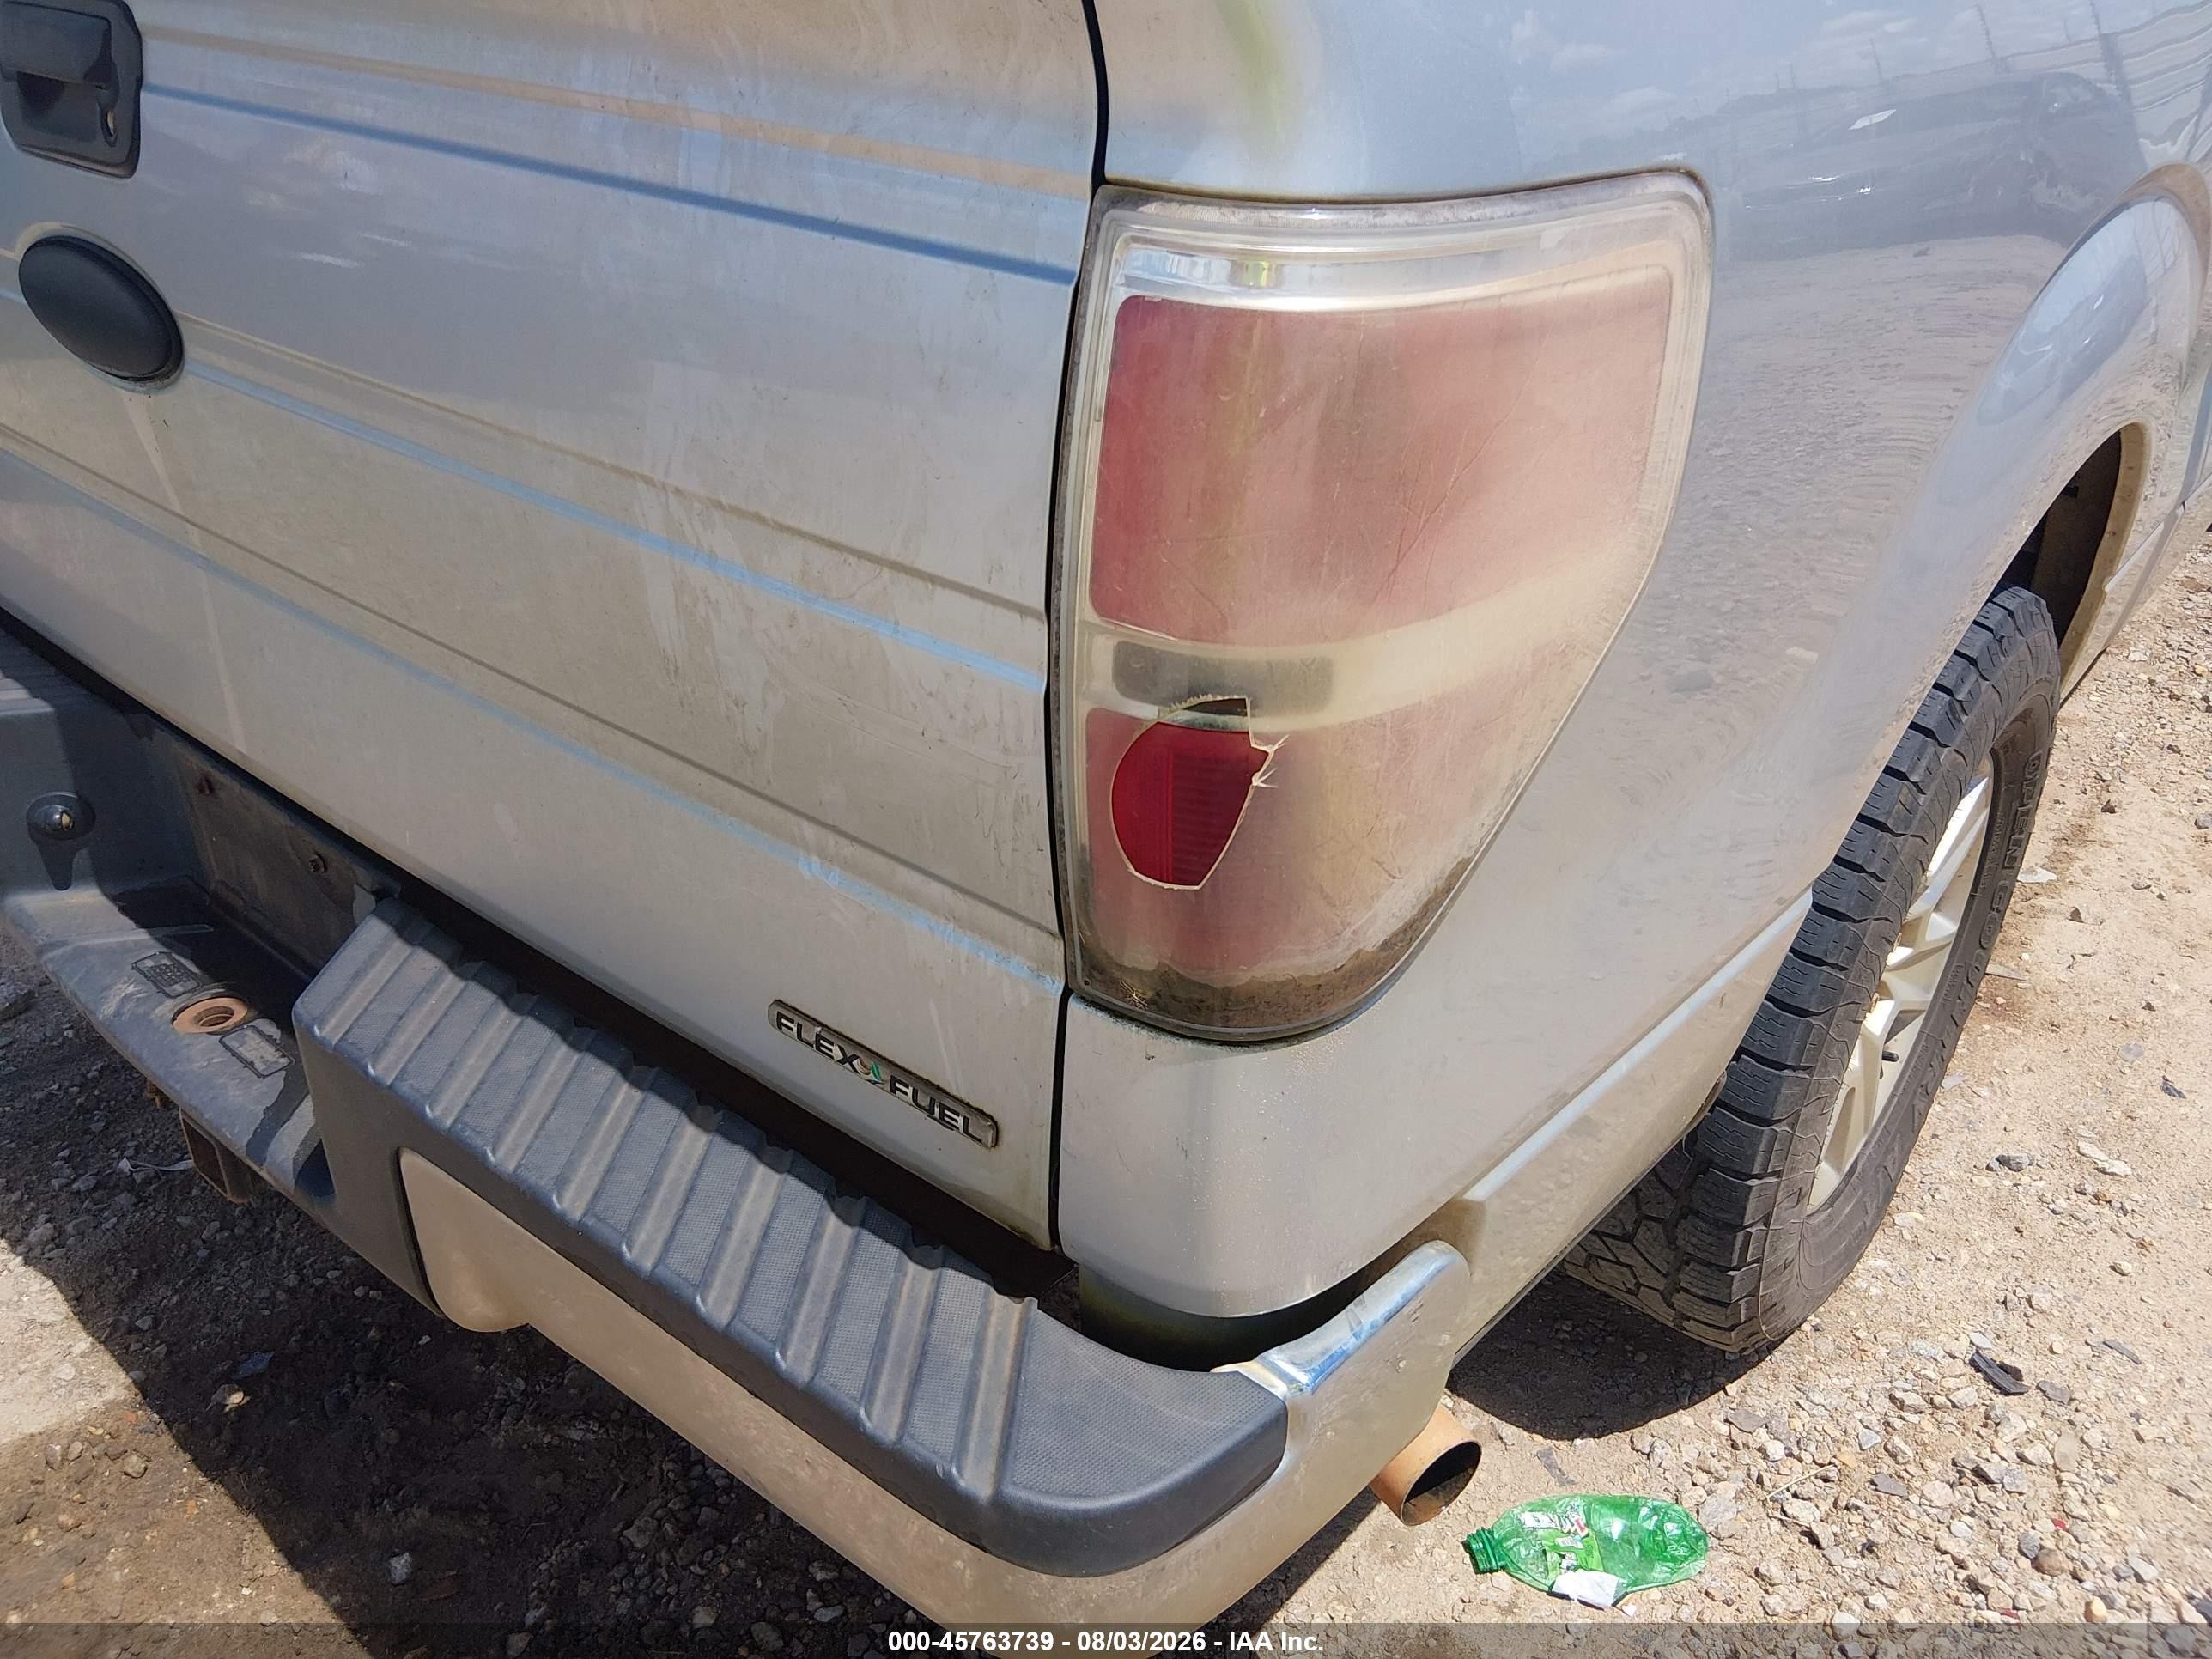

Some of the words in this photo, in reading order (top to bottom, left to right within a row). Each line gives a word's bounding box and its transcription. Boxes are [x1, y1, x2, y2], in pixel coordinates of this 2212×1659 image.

[2001, 749, 2044, 870] OPEN
[776, 1011, 860, 1073] FLEX
[890, 1075, 983, 1143] FUEL
